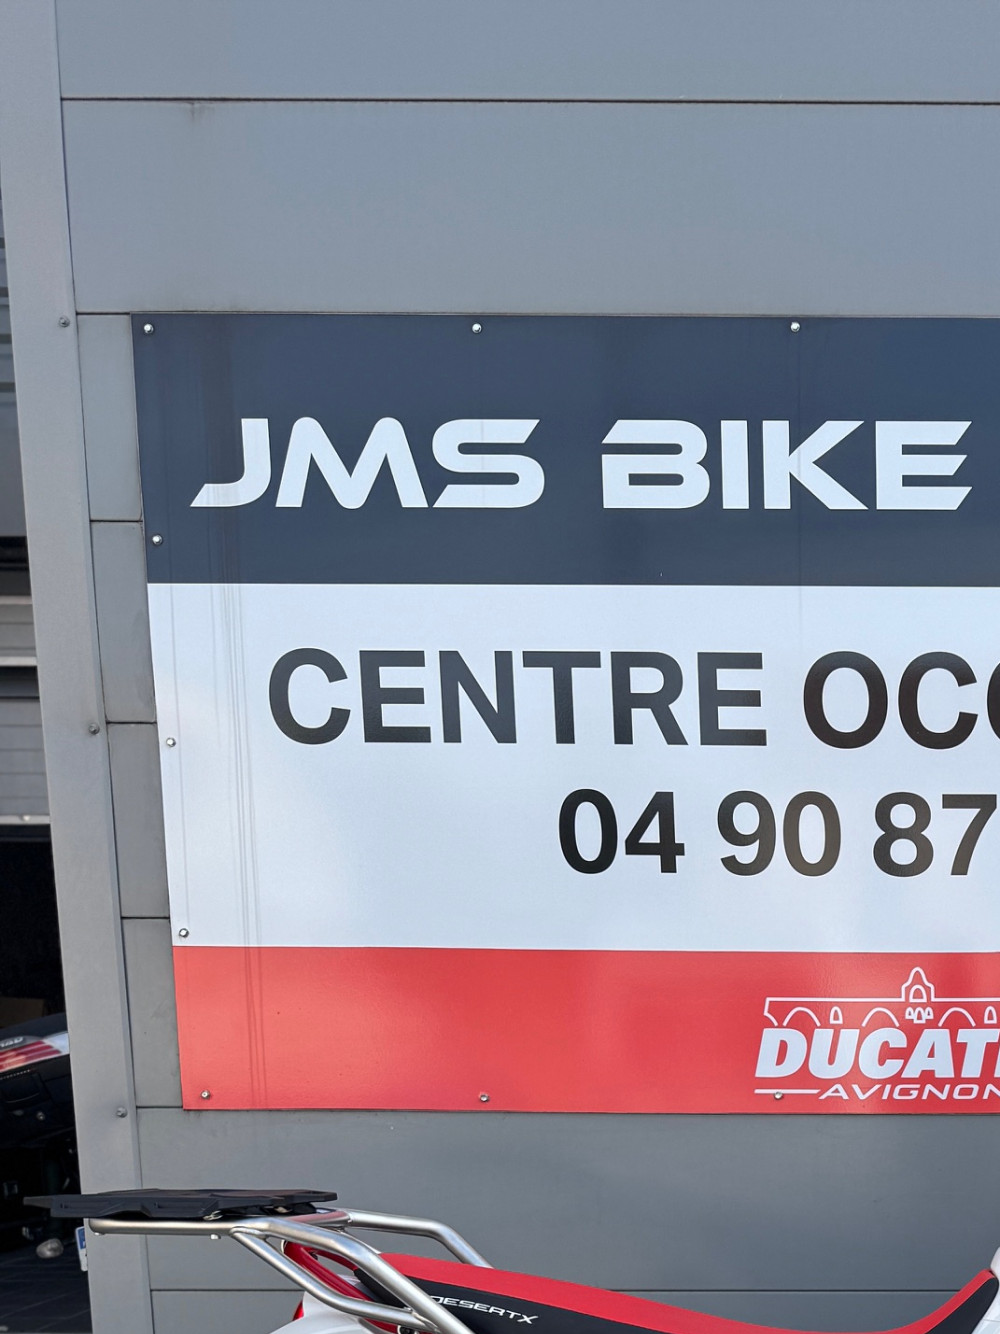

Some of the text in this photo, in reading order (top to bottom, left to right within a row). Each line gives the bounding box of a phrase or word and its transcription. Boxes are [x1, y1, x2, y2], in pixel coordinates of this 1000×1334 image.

[190, 417, 546, 511] JMS
[601, 419, 973, 511] BIKE
[268, 647, 768, 747] CENTRE
[558, 788, 686, 875] 04
[717, 790, 842, 877] 90
[873, 791, 998, 878] 87
[429, 1295, 539, 1325] DESERTX
